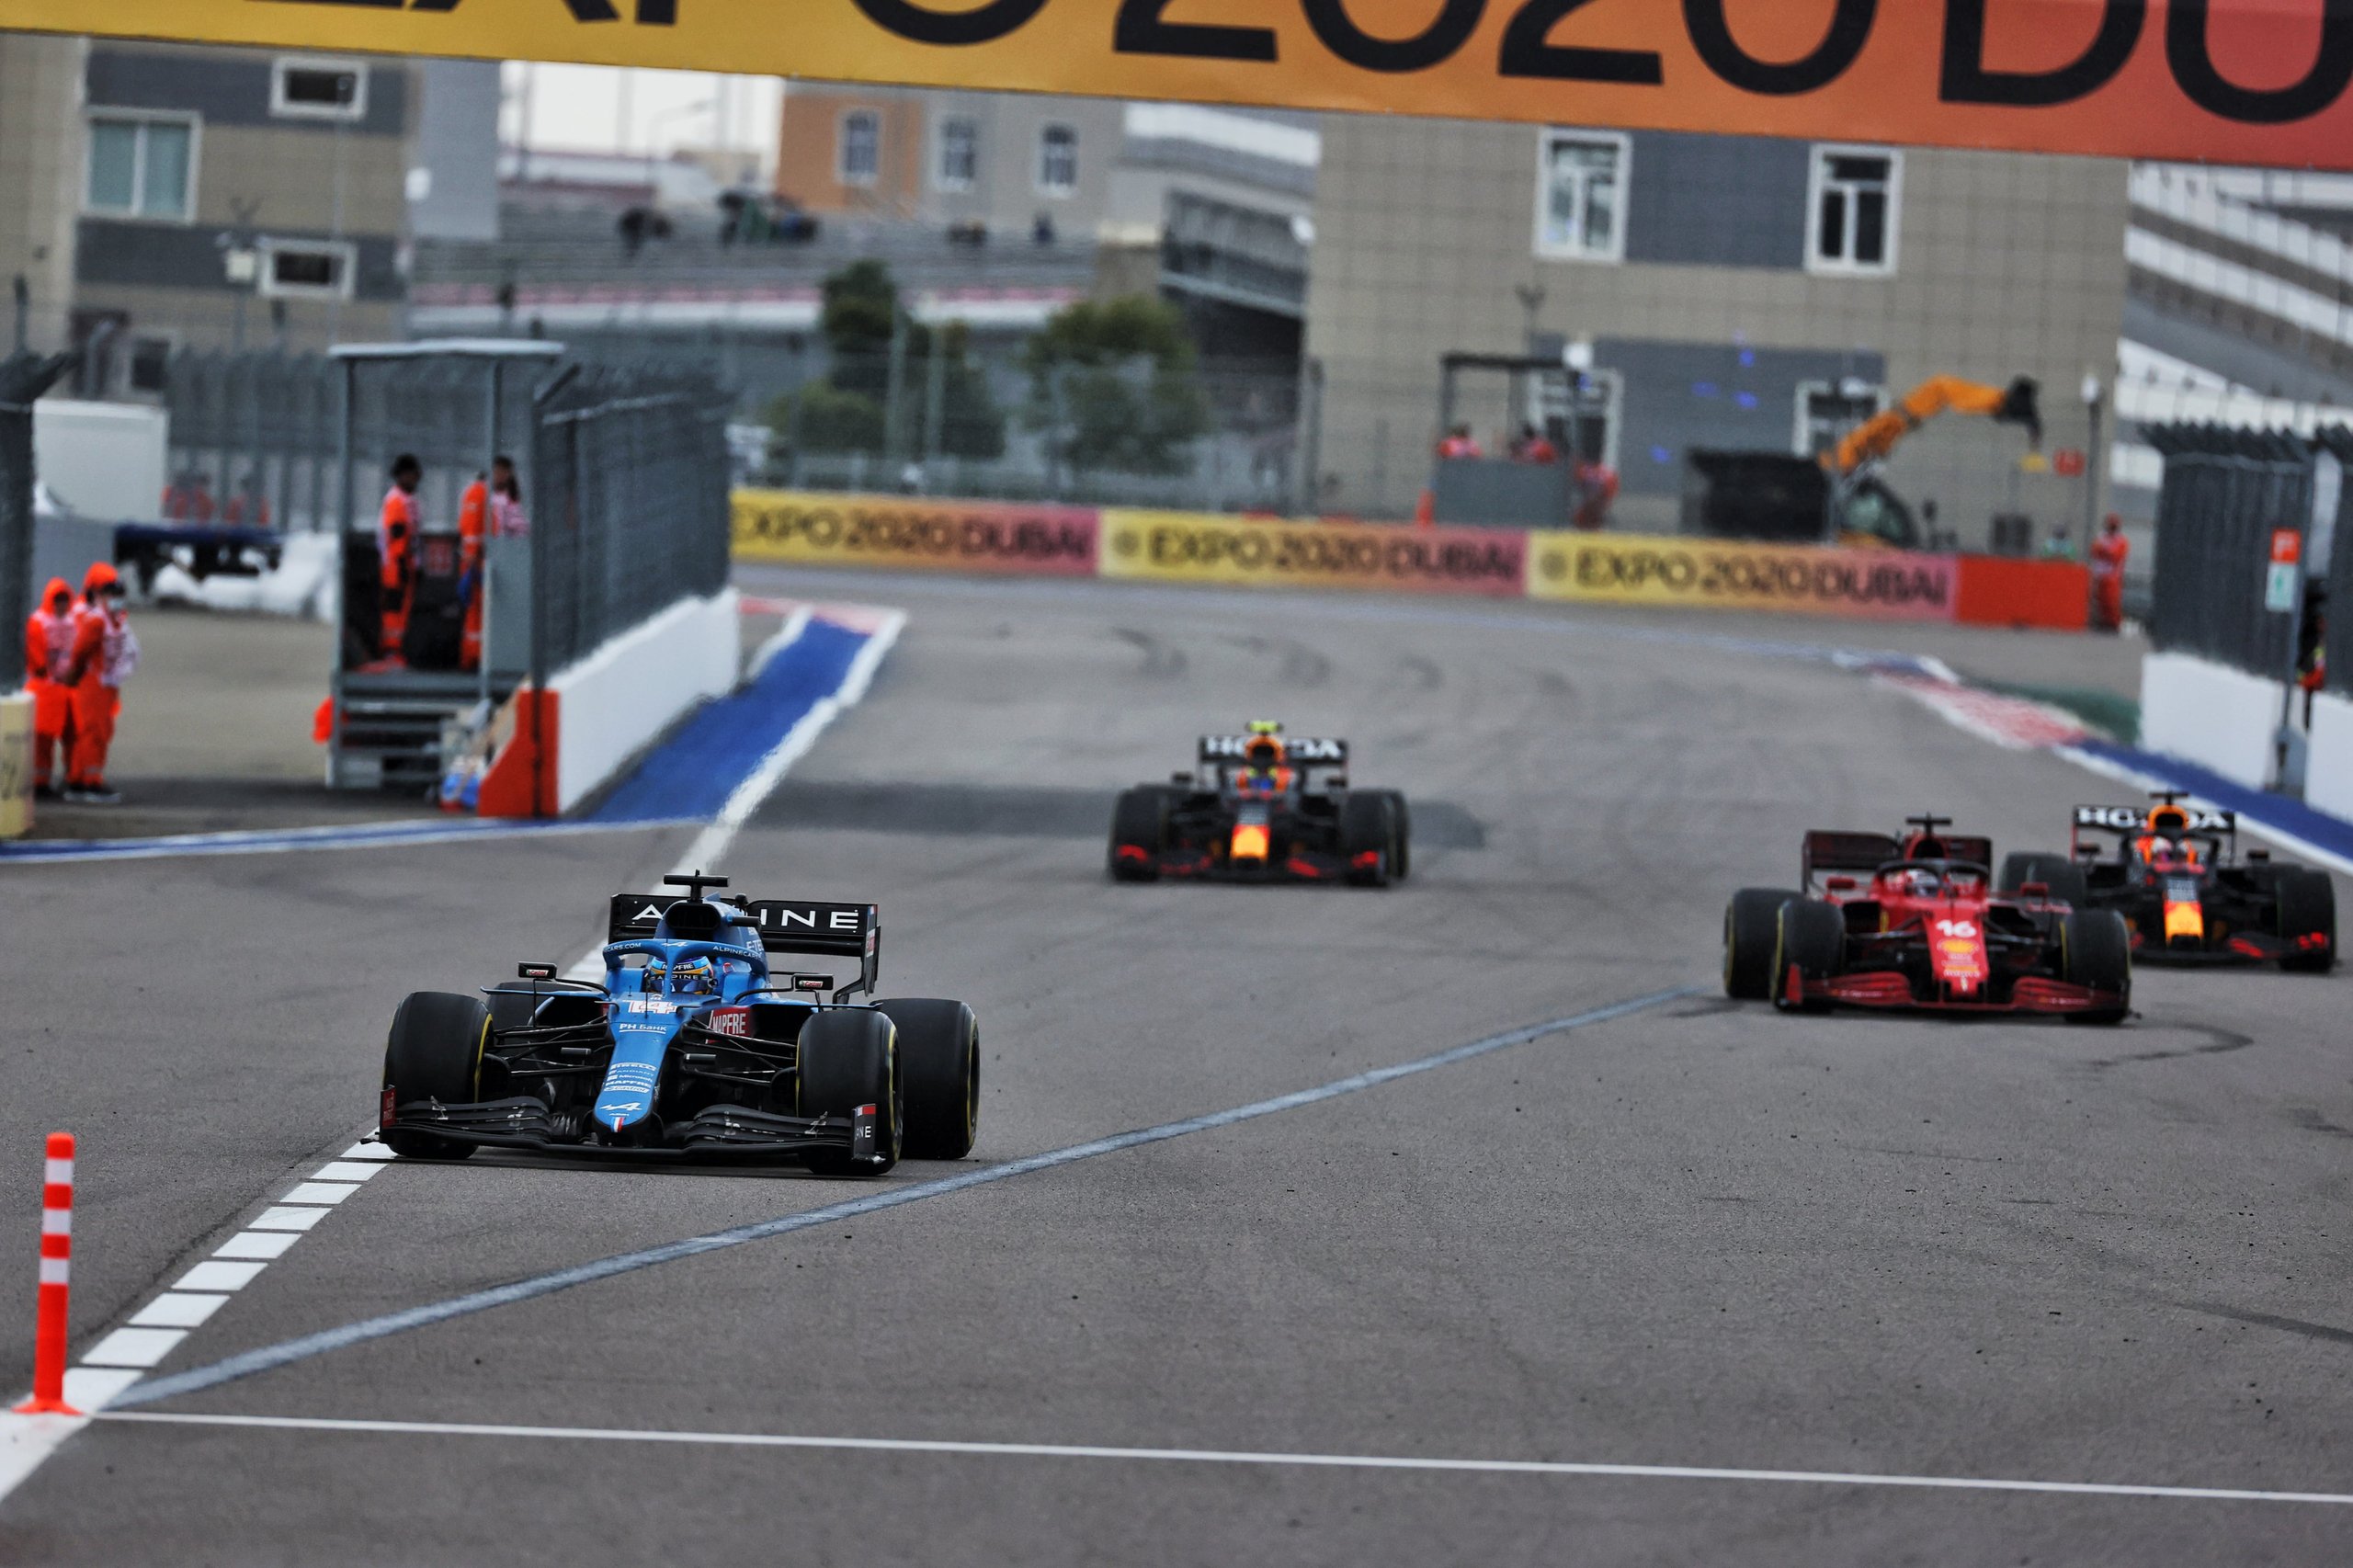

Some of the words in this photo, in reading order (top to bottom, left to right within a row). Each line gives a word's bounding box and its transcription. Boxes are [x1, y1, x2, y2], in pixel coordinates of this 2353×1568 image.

[1149, 524, 1271, 570] EXPO
[1275, 528, 1381, 572] 2020
[1385, 536, 1516, 581] DUBAI
[1575, 547, 1698, 590] EXPO
[1699, 553, 1811, 596] 2020
[1814, 560, 1947, 607] DUBAI
[632, 904, 858, 929] AINE
[1936, 919, 1976, 937] 16
[712, 1013, 746, 1034] MAPFRE
